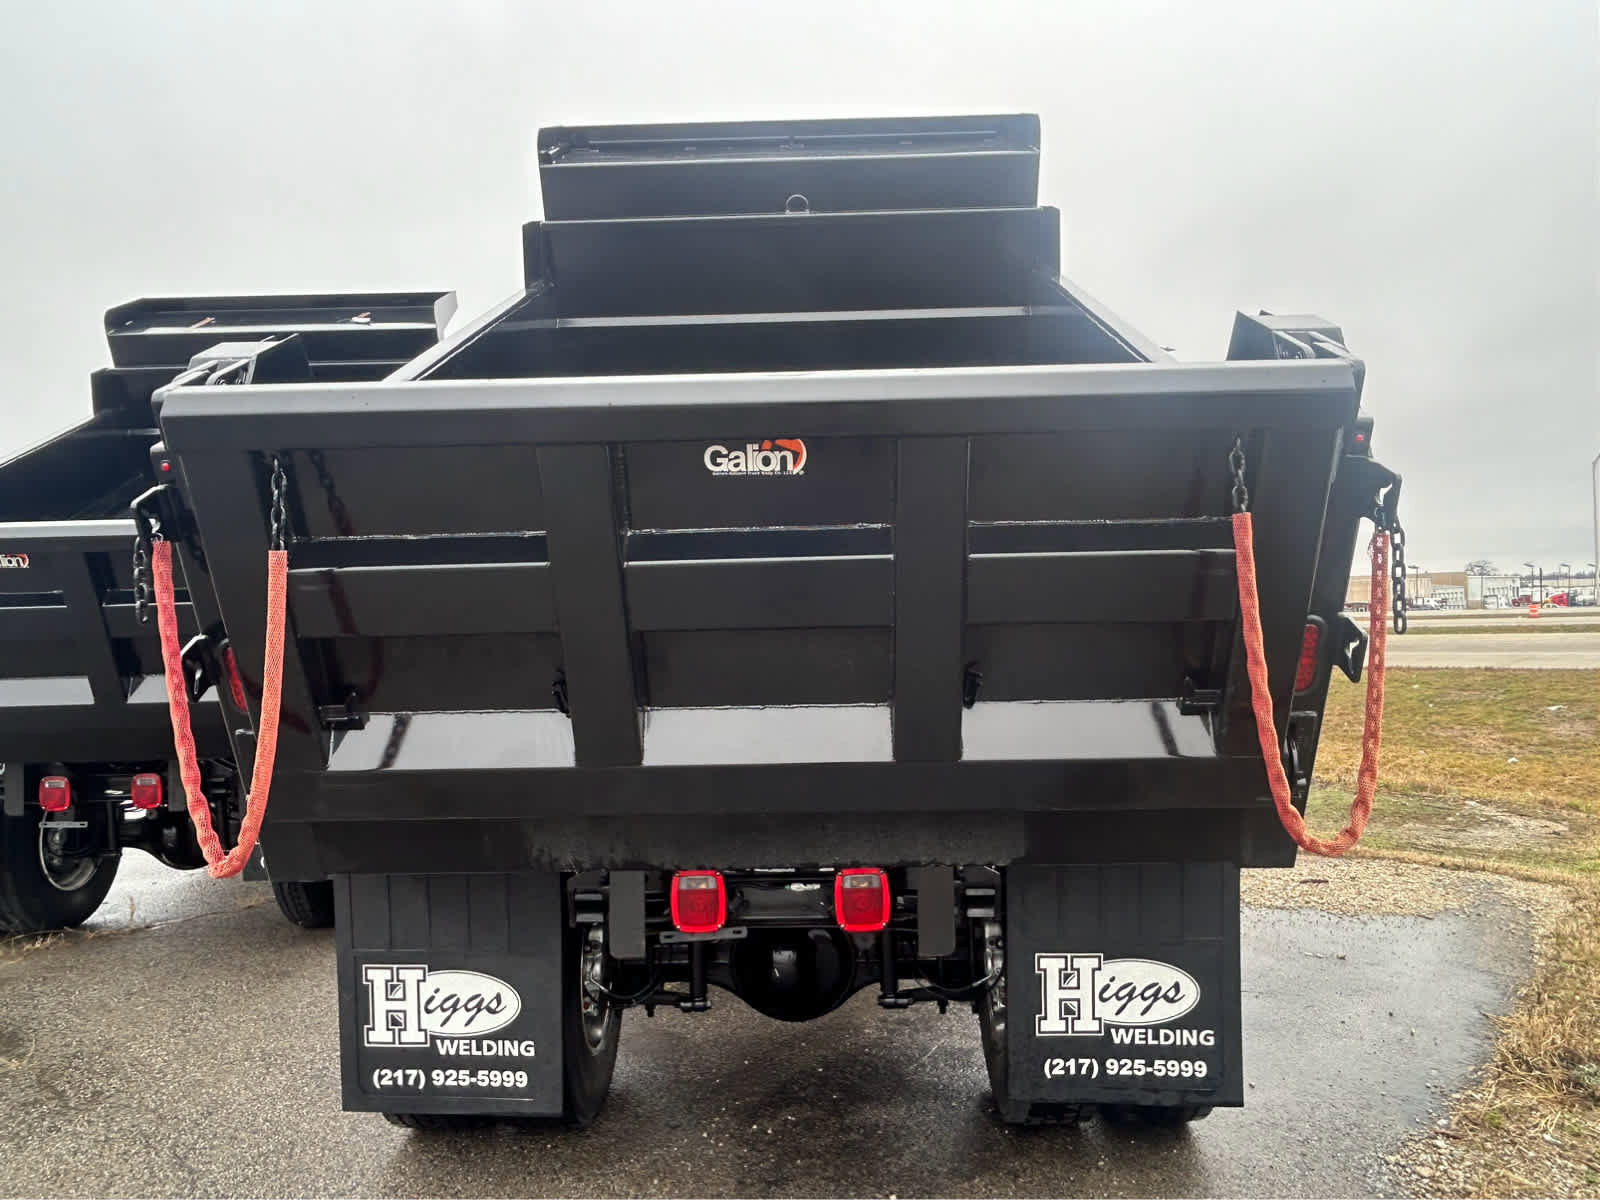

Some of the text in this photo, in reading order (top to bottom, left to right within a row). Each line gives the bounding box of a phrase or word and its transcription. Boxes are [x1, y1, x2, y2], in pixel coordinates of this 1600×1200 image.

[704, 441, 795, 472] Galion
[1034, 953, 1185, 1036] Higgs
[362, 964, 507, 1048] Higgs
[436, 1039, 536, 1057] WELDING
[1111, 1028, 1216, 1046] WELDING
[372, 1068, 528, 1090] (217) 925-5999
[1043, 1058, 1208, 1079] (217) 925-5999
